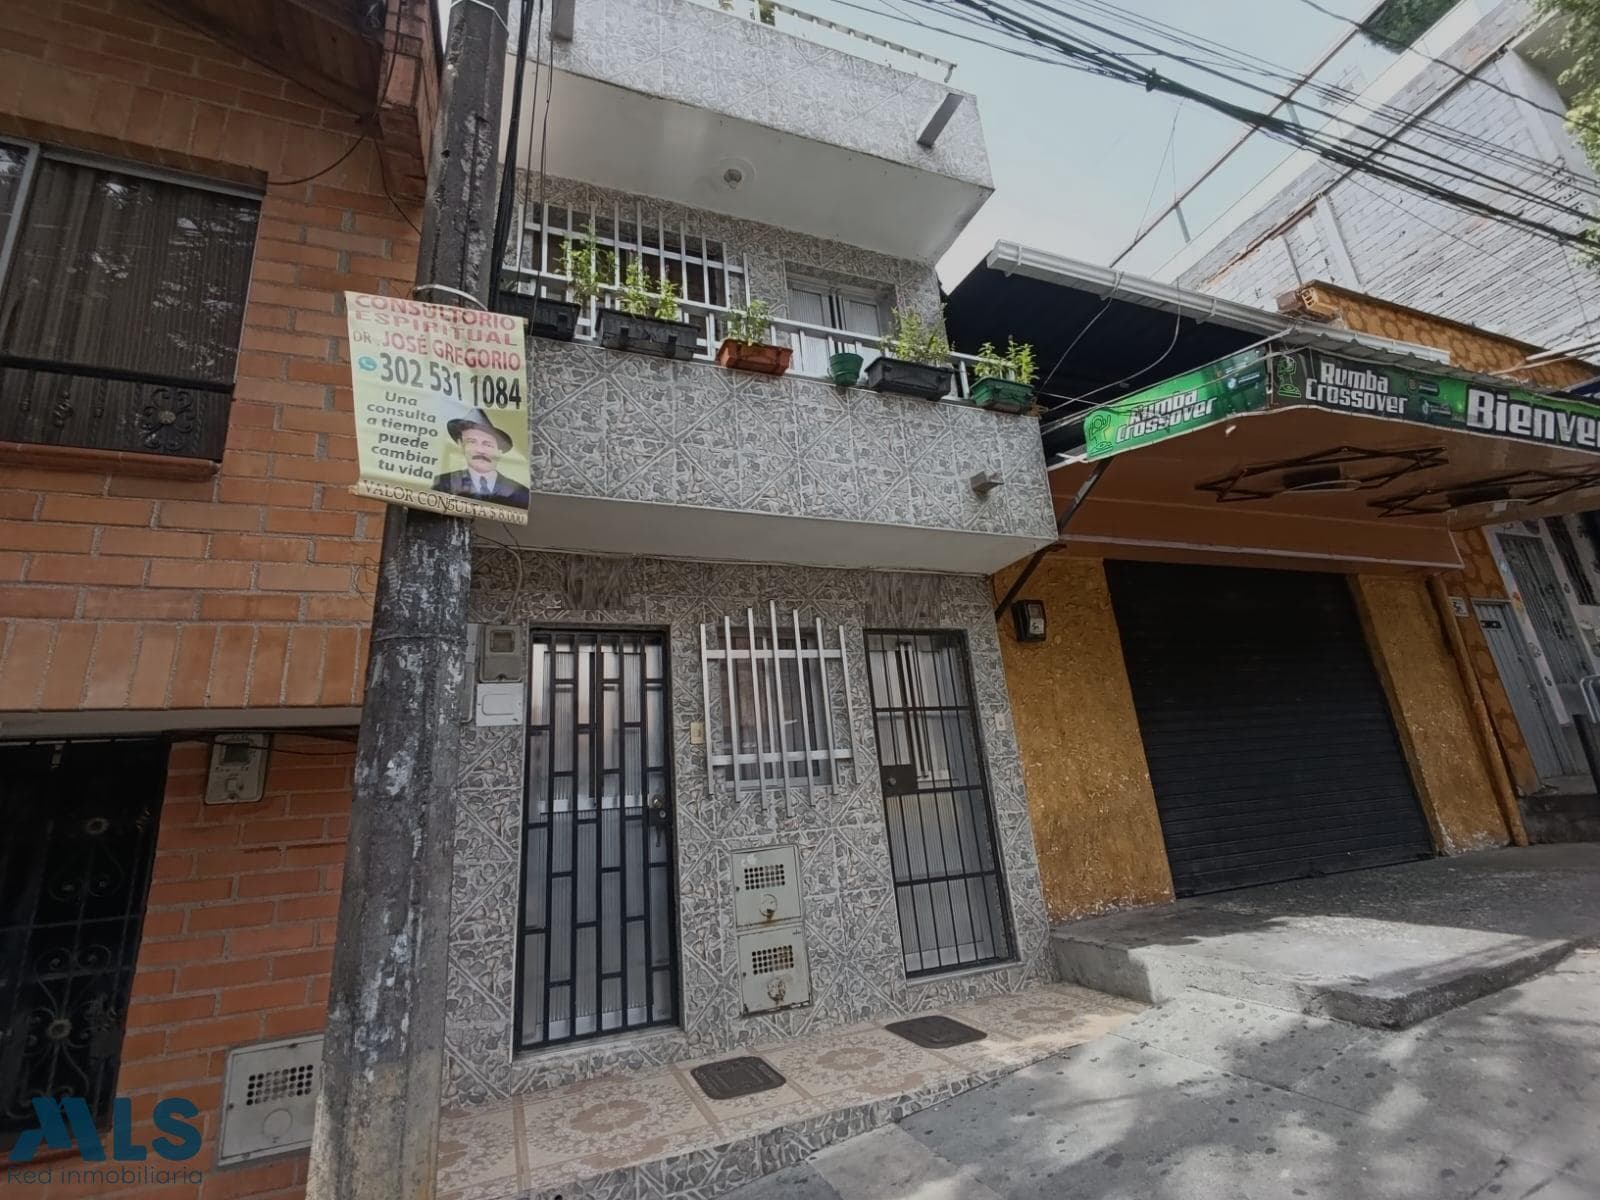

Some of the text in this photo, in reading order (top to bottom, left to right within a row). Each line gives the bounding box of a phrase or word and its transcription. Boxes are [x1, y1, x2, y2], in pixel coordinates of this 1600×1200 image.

[355, 294, 515, 330] CONSULTORIO
[355, 311, 518, 346] ESPIRITUAL
[382, 331, 428, 355] JOSÉ
[432, 339, 521, 372] GREGORIO
[380, 352, 522, 410] 302 531 1084
[1321, 361, 1388, 394] Rumba
[385, 391, 418, 406] Una
[1129, 389, 1198, 425] Rumba
[1305, 377, 1408, 414] Crossover
[366, 404, 437, 423] consulta
[366, 417, 438, 437] a tiempo
[371, 445, 439, 465] cambiar
[378, 432, 429, 450] puede
[378, 459, 433, 479] tu vida
[364, 479, 414, 502] VALOR
[417, 491, 486, 517] CONSULTA
